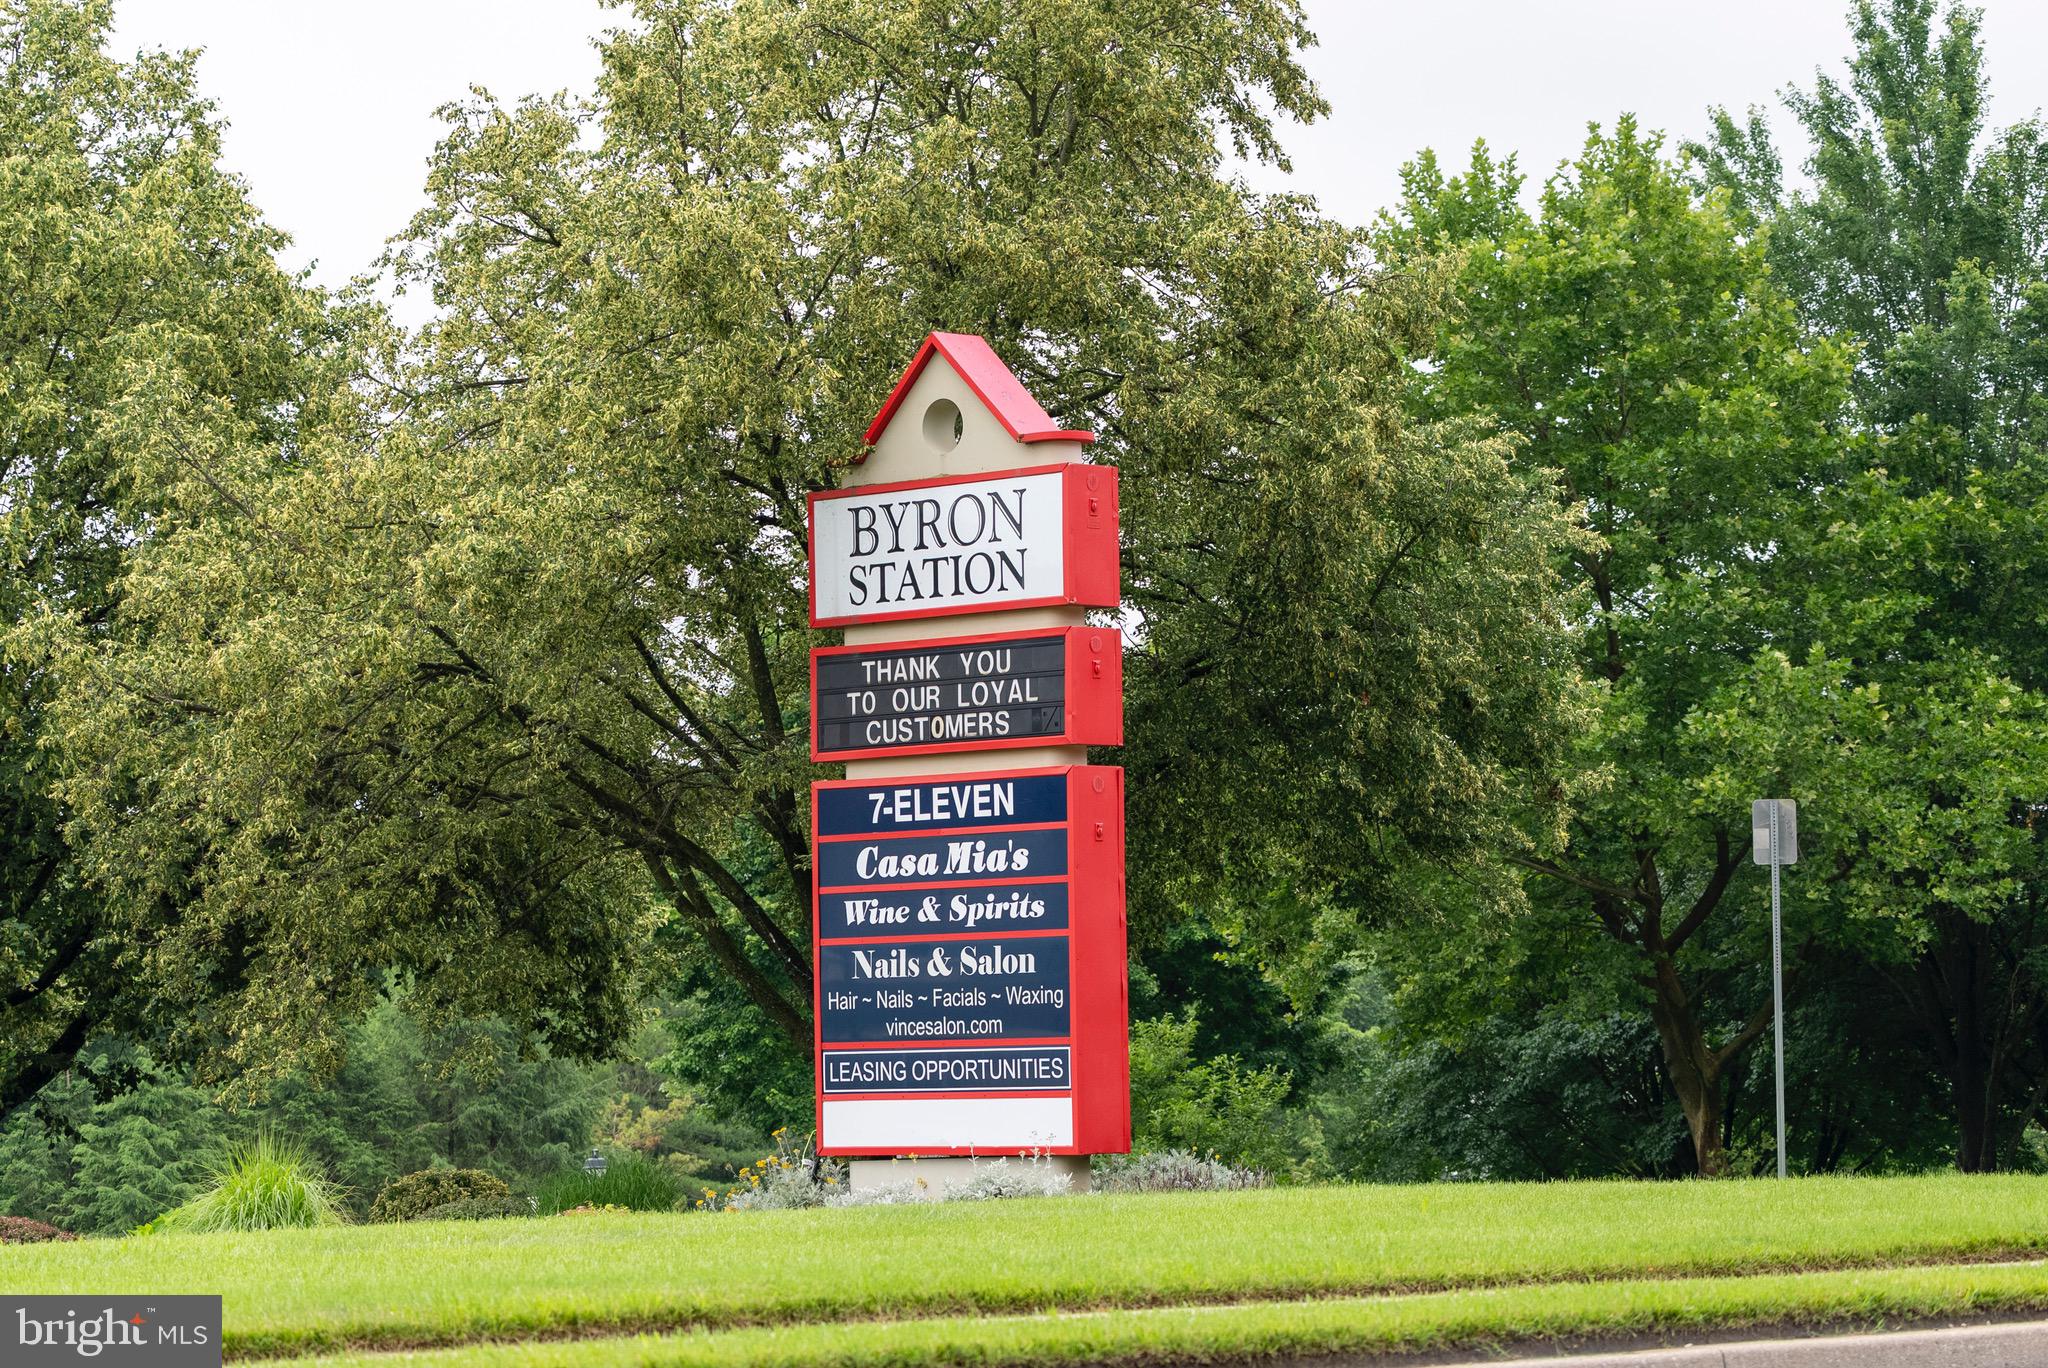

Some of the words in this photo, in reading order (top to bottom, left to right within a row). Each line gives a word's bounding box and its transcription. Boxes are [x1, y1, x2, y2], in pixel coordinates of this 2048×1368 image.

[848, 489, 1027, 558] BYRON
[849, 548, 1027, 606] STATION
[861, 654, 941, 684] THANK
[960, 649, 1011, 677] YOU
[847, 691, 876, 716] TO
[892, 685, 941, 712] OUR
[957, 678, 1038, 708] LOYAL
[866, 710, 1010, 745] CUSTOMERS
[868, 782, 1014, 824] 7-ELEVEN
[856, 846, 938, 880] Casa
[943, 839, 1029, 875] Mia's
[844, 899, 910, 926] Wine
[917, 896, 941, 922] &
[949, 892, 1045, 927] Spirits
[852, 948, 920, 980] Nails
[927, 947, 953, 977] &
[960, 945, 1036, 976] Salon
[828, 991, 858, 1010] Hair
[876, 989, 913, 1009] Nails
[933, 987, 986, 1007] Facials
[1006, 985, 1064, 1009] Waxing
[886, 1016, 1003, 1036] vincesalon.com
[829, 1062, 907, 1082] LEASING
[912, 1057, 1064, 1080] OPPORTUNITIES
